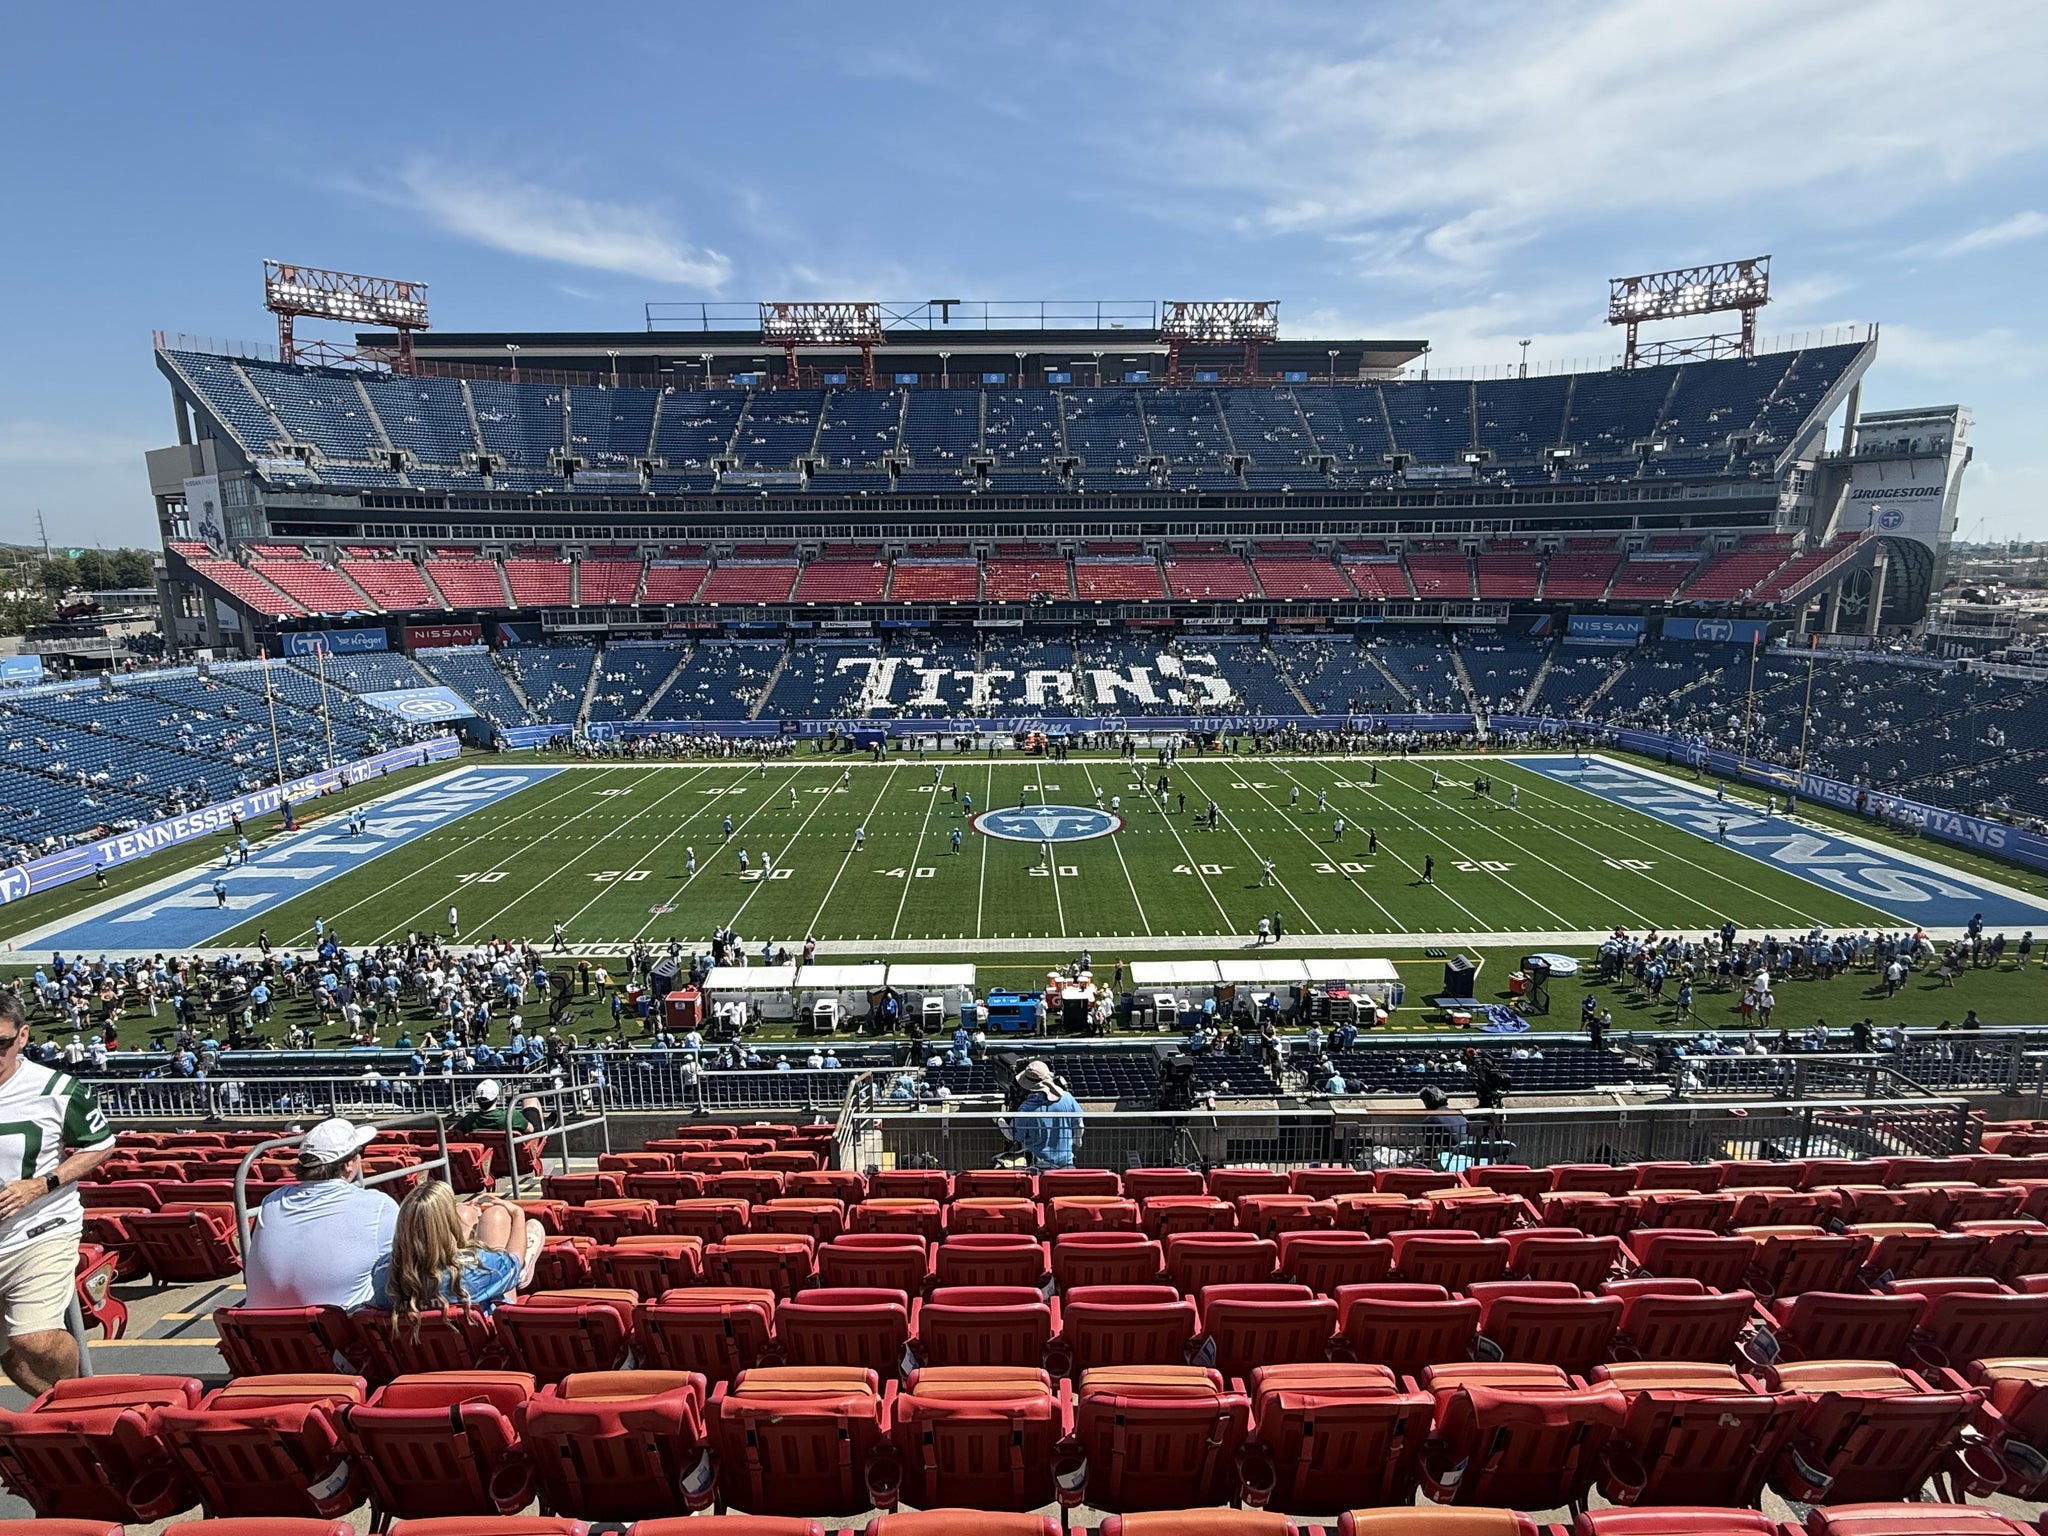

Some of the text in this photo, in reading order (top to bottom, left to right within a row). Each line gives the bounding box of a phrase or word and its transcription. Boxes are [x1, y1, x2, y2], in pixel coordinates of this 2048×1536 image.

[1851, 486, 1943, 499] BRIDGESTONE
[1572, 621, 1639, 632] NISSAN
[415, 628, 473, 639] NISSAN
[351, 634, 382, 648] Kroger
[837, 653, 1237, 708] TITANS
[97, 800, 247, 863] TENNESSEE
[248, 778, 317, 815] TITANS
[1546, 767, 1983, 901] TITANS
[109, 775, 528, 924] TITANS
[1172, 864, 1224, 875] 40
[1310, 862, 1366, 873] 30
[1450, 860, 1511, 872] 20
[1602, 859, 1654, 870] 10
[460, 872, 510, 882] 10
[592, 871, 653, 881] 20
[739, 868, 795, 880] 30
[885, 867, 937, 879] 40
[1028, 866, 1079, 877] 50
